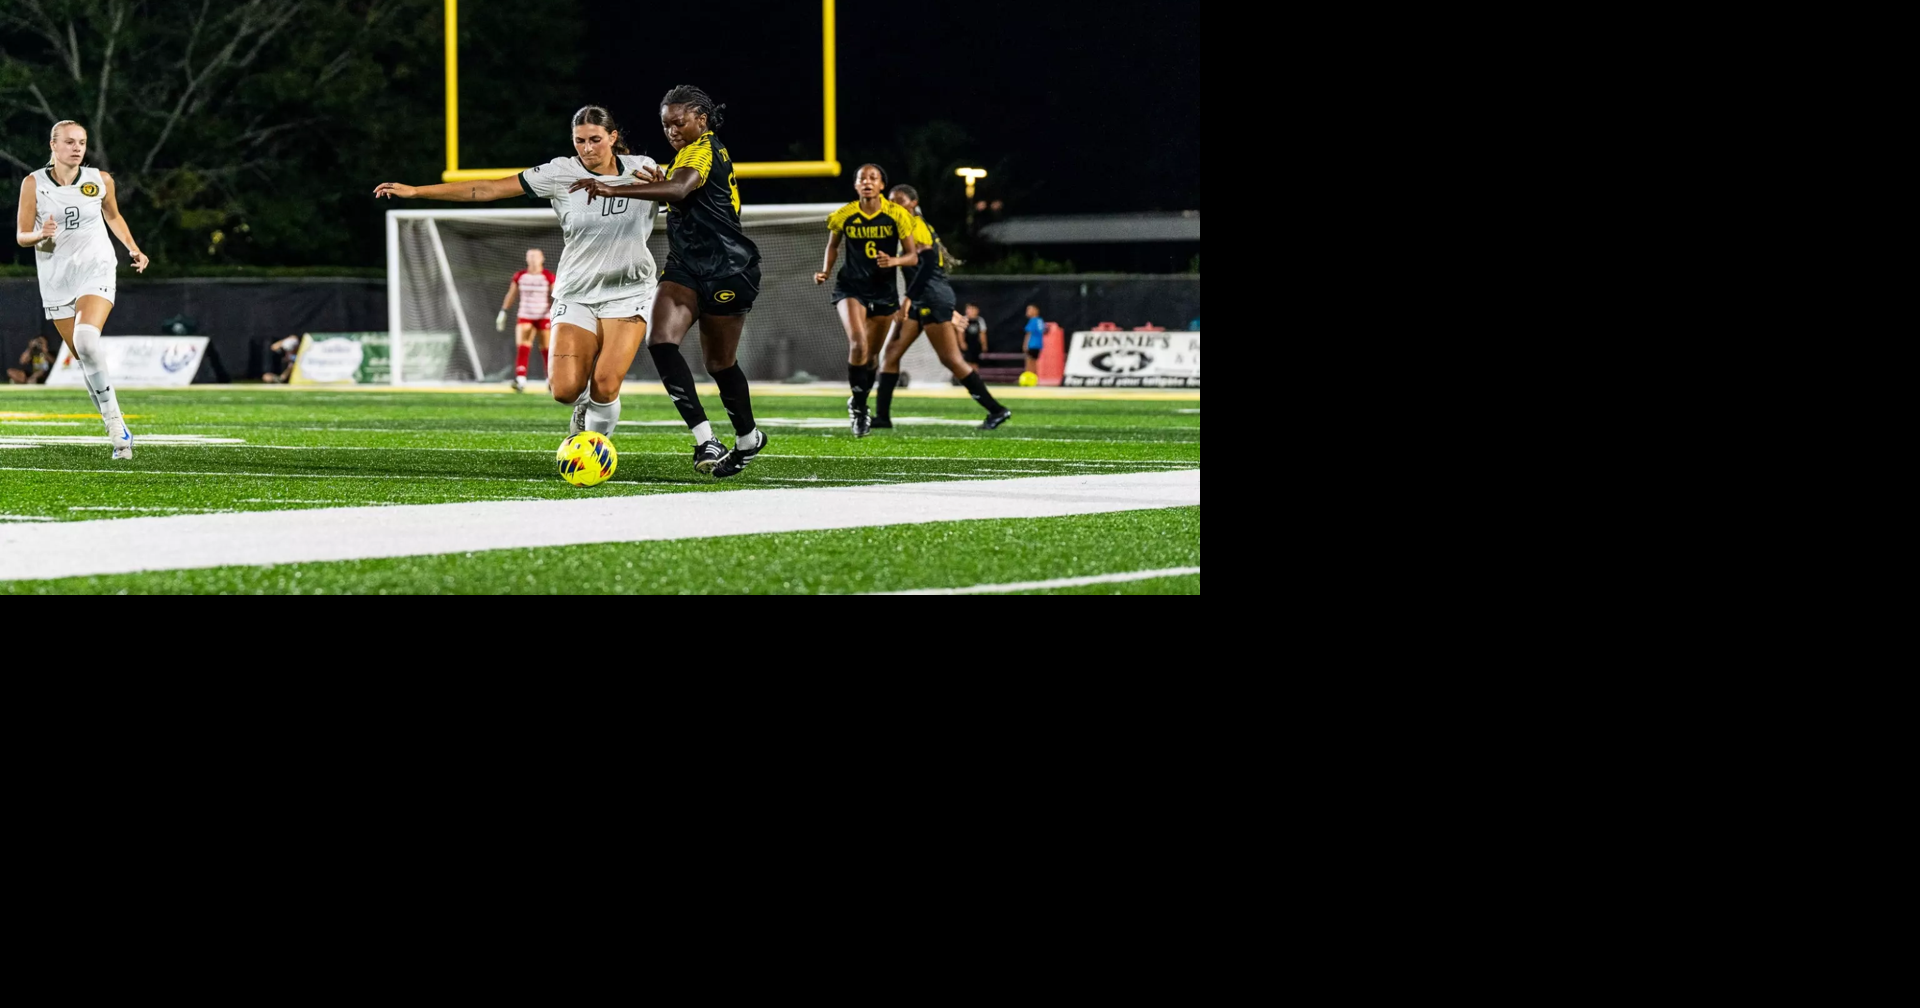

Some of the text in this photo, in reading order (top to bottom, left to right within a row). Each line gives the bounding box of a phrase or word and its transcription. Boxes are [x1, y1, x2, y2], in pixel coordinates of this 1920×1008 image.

[64, 206, 80, 230] 2
[864, 240, 877, 258] 6
[1080, 333, 1171, 349] RONNIE'S
